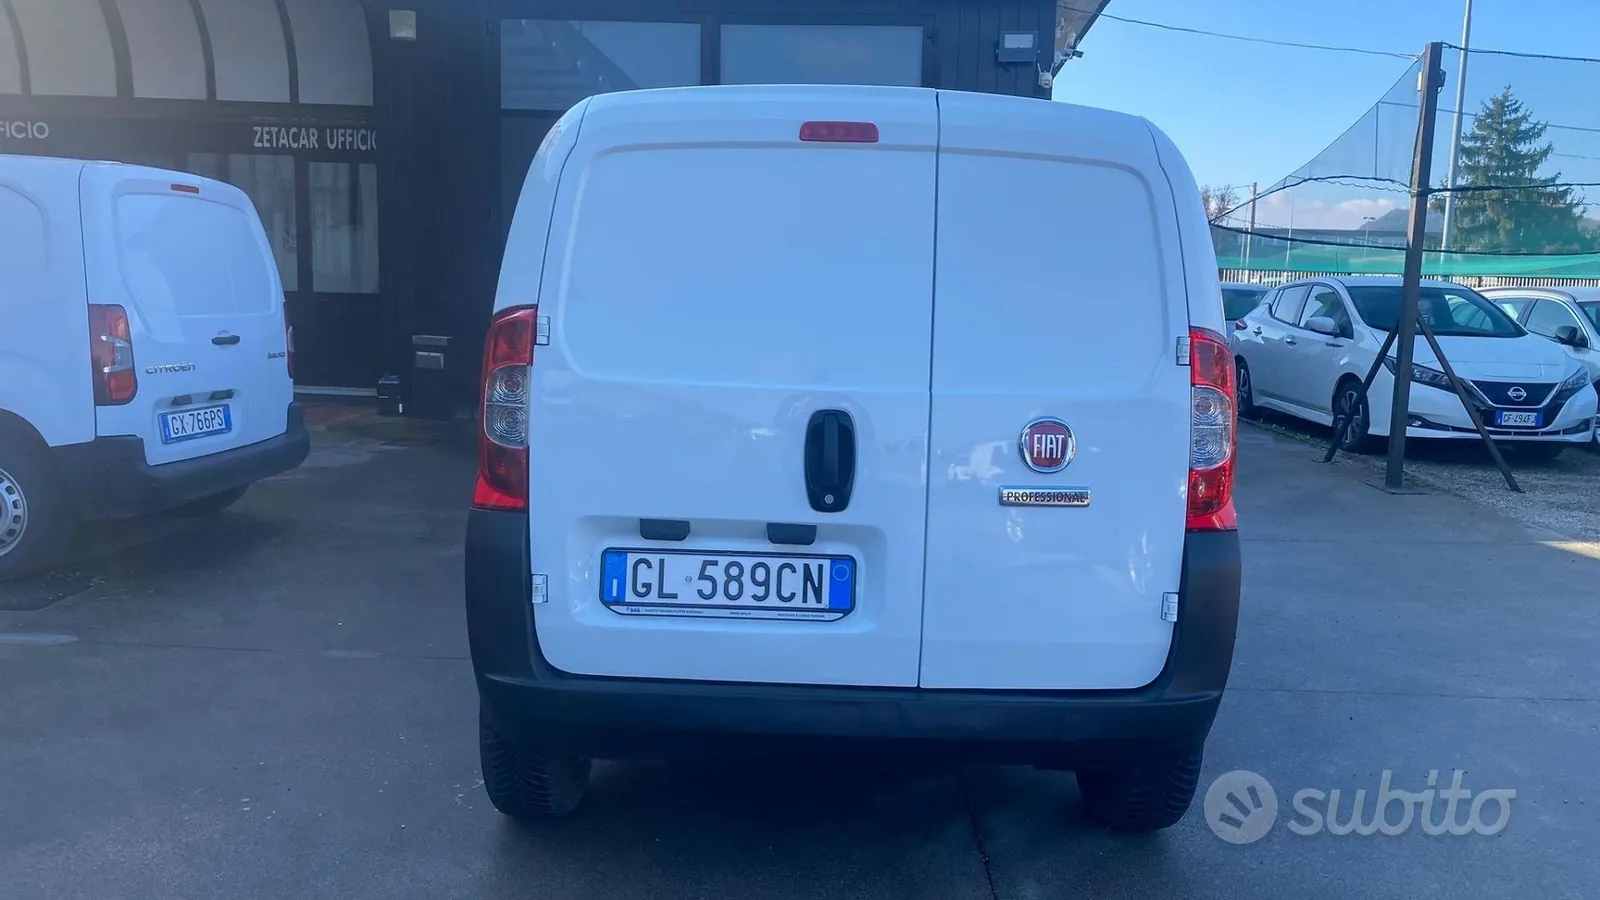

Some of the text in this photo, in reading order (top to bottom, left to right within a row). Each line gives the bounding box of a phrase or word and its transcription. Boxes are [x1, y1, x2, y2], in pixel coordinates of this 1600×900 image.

[253, 126, 319, 148] ZETACAR
[171, 409, 224, 435] GX 766PS
[1033, 433, 1065, 459] FIAT
[1006, 491, 1088, 503] PROFESSIONAL
[632, 558, 823, 604] GL 589CN
